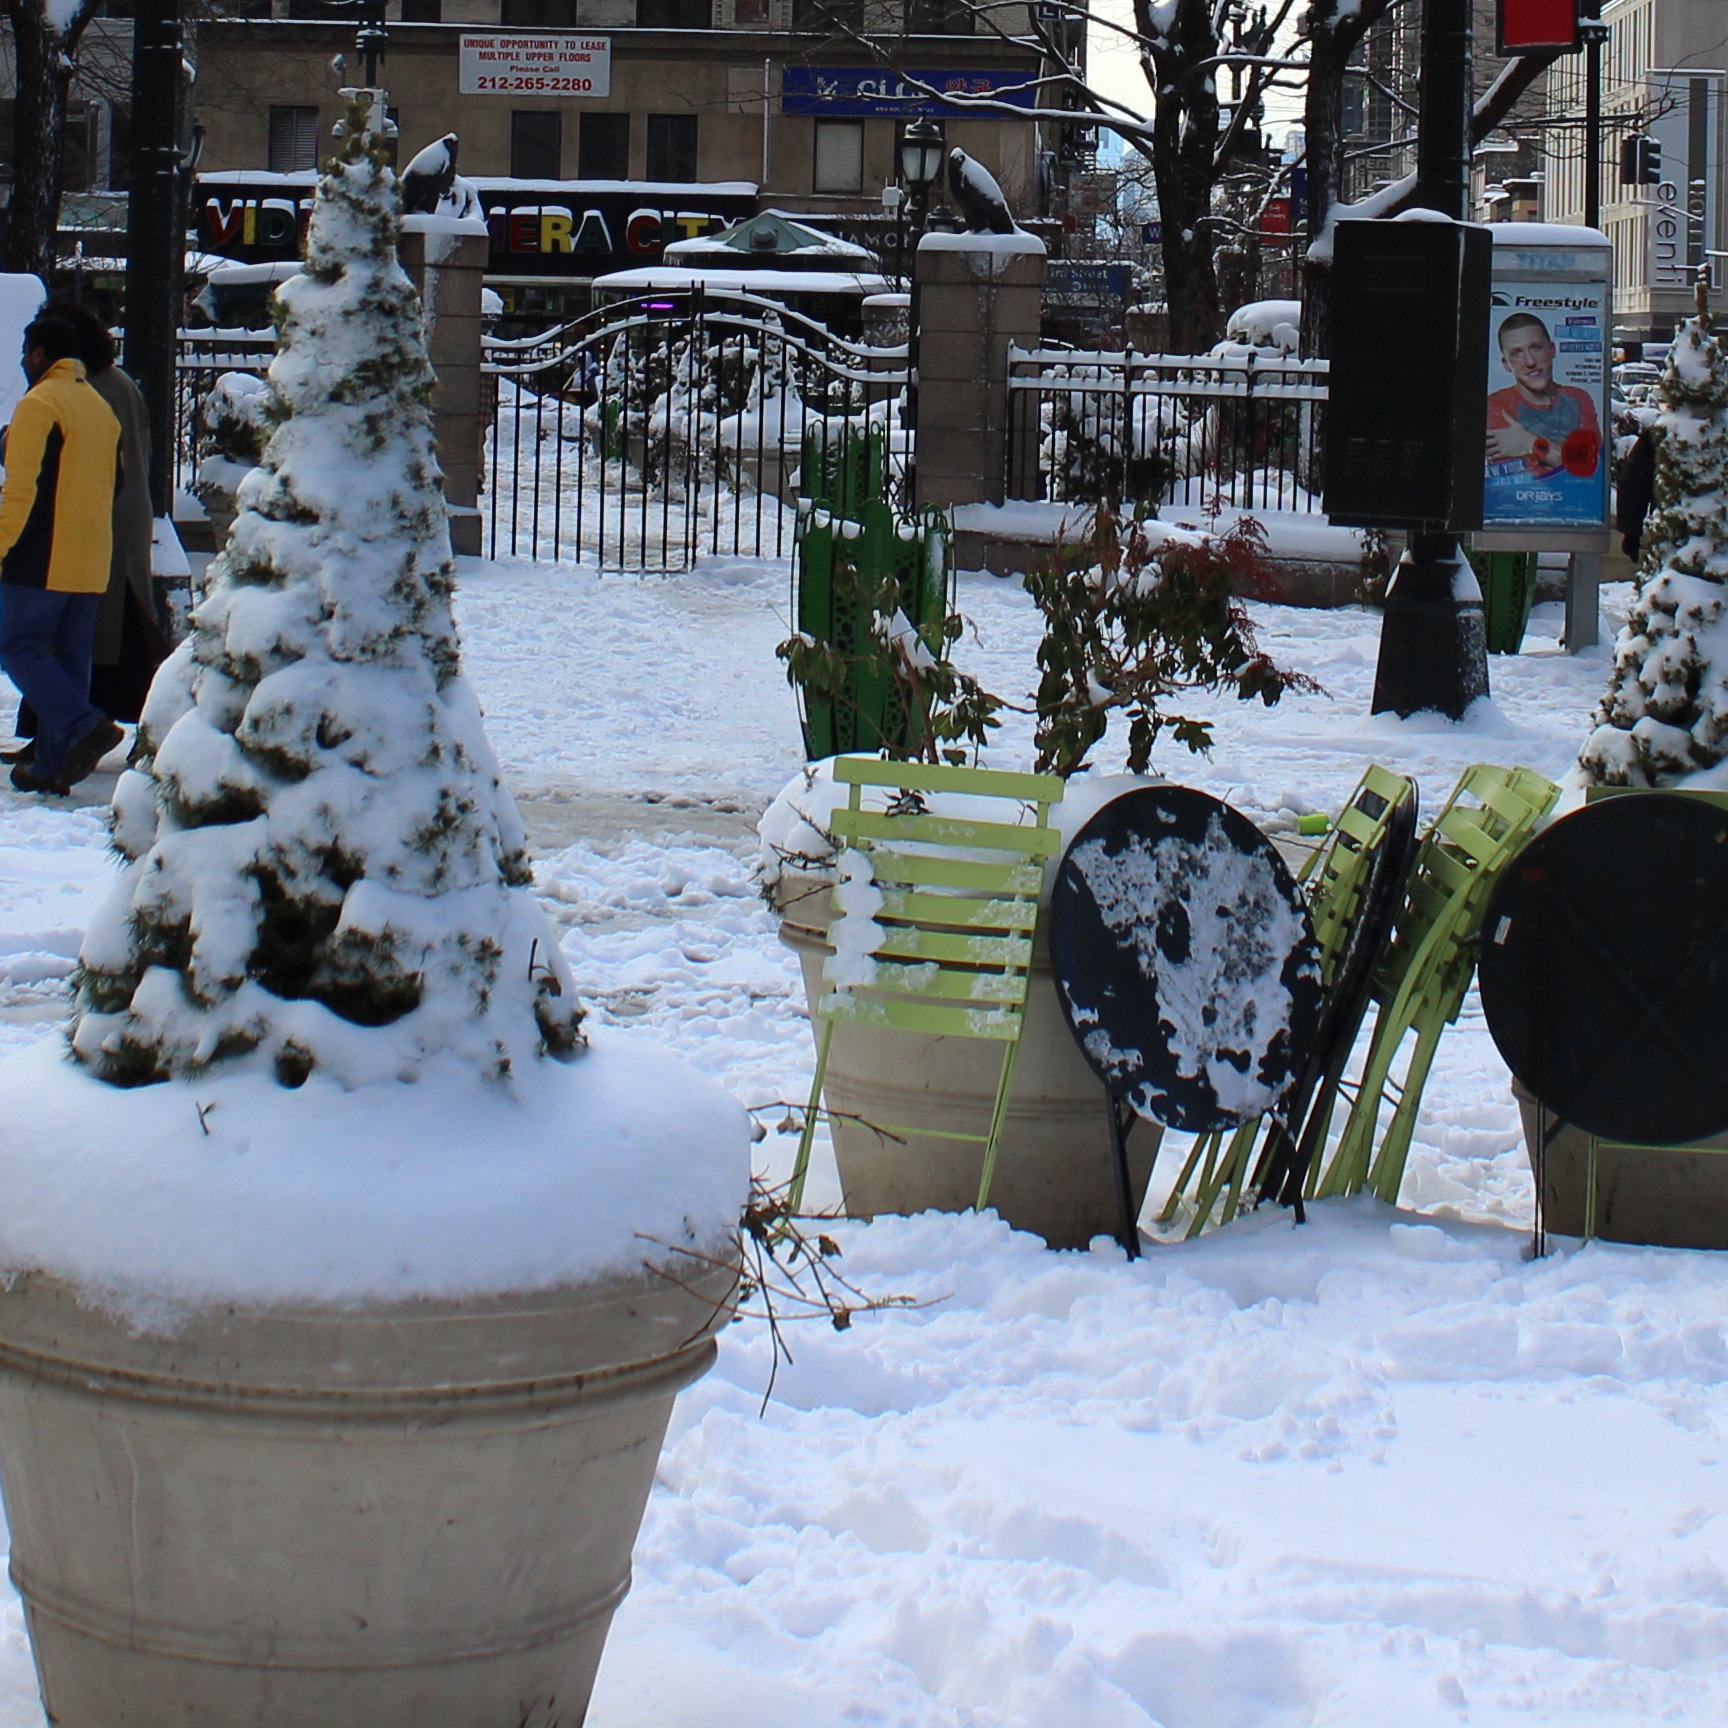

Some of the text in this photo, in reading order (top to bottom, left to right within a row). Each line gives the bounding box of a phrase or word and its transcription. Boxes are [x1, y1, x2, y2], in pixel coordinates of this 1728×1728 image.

[463, 38, 607, 51] UNIQUE OPPORTUNITY TO LEASE
[478, 51, 591, 63] MULTIPLE UPPER FLOORS
[510, 65, 560, 73] Please Call
[477, 76, 592, 91] 212-265-2280
[205, 197, 314, 247] VID
[488, 205, 614, 255] ERA
[1656, 181, 1683, 283] eventi
[1514, 295, 1599, 311] Freestyle
